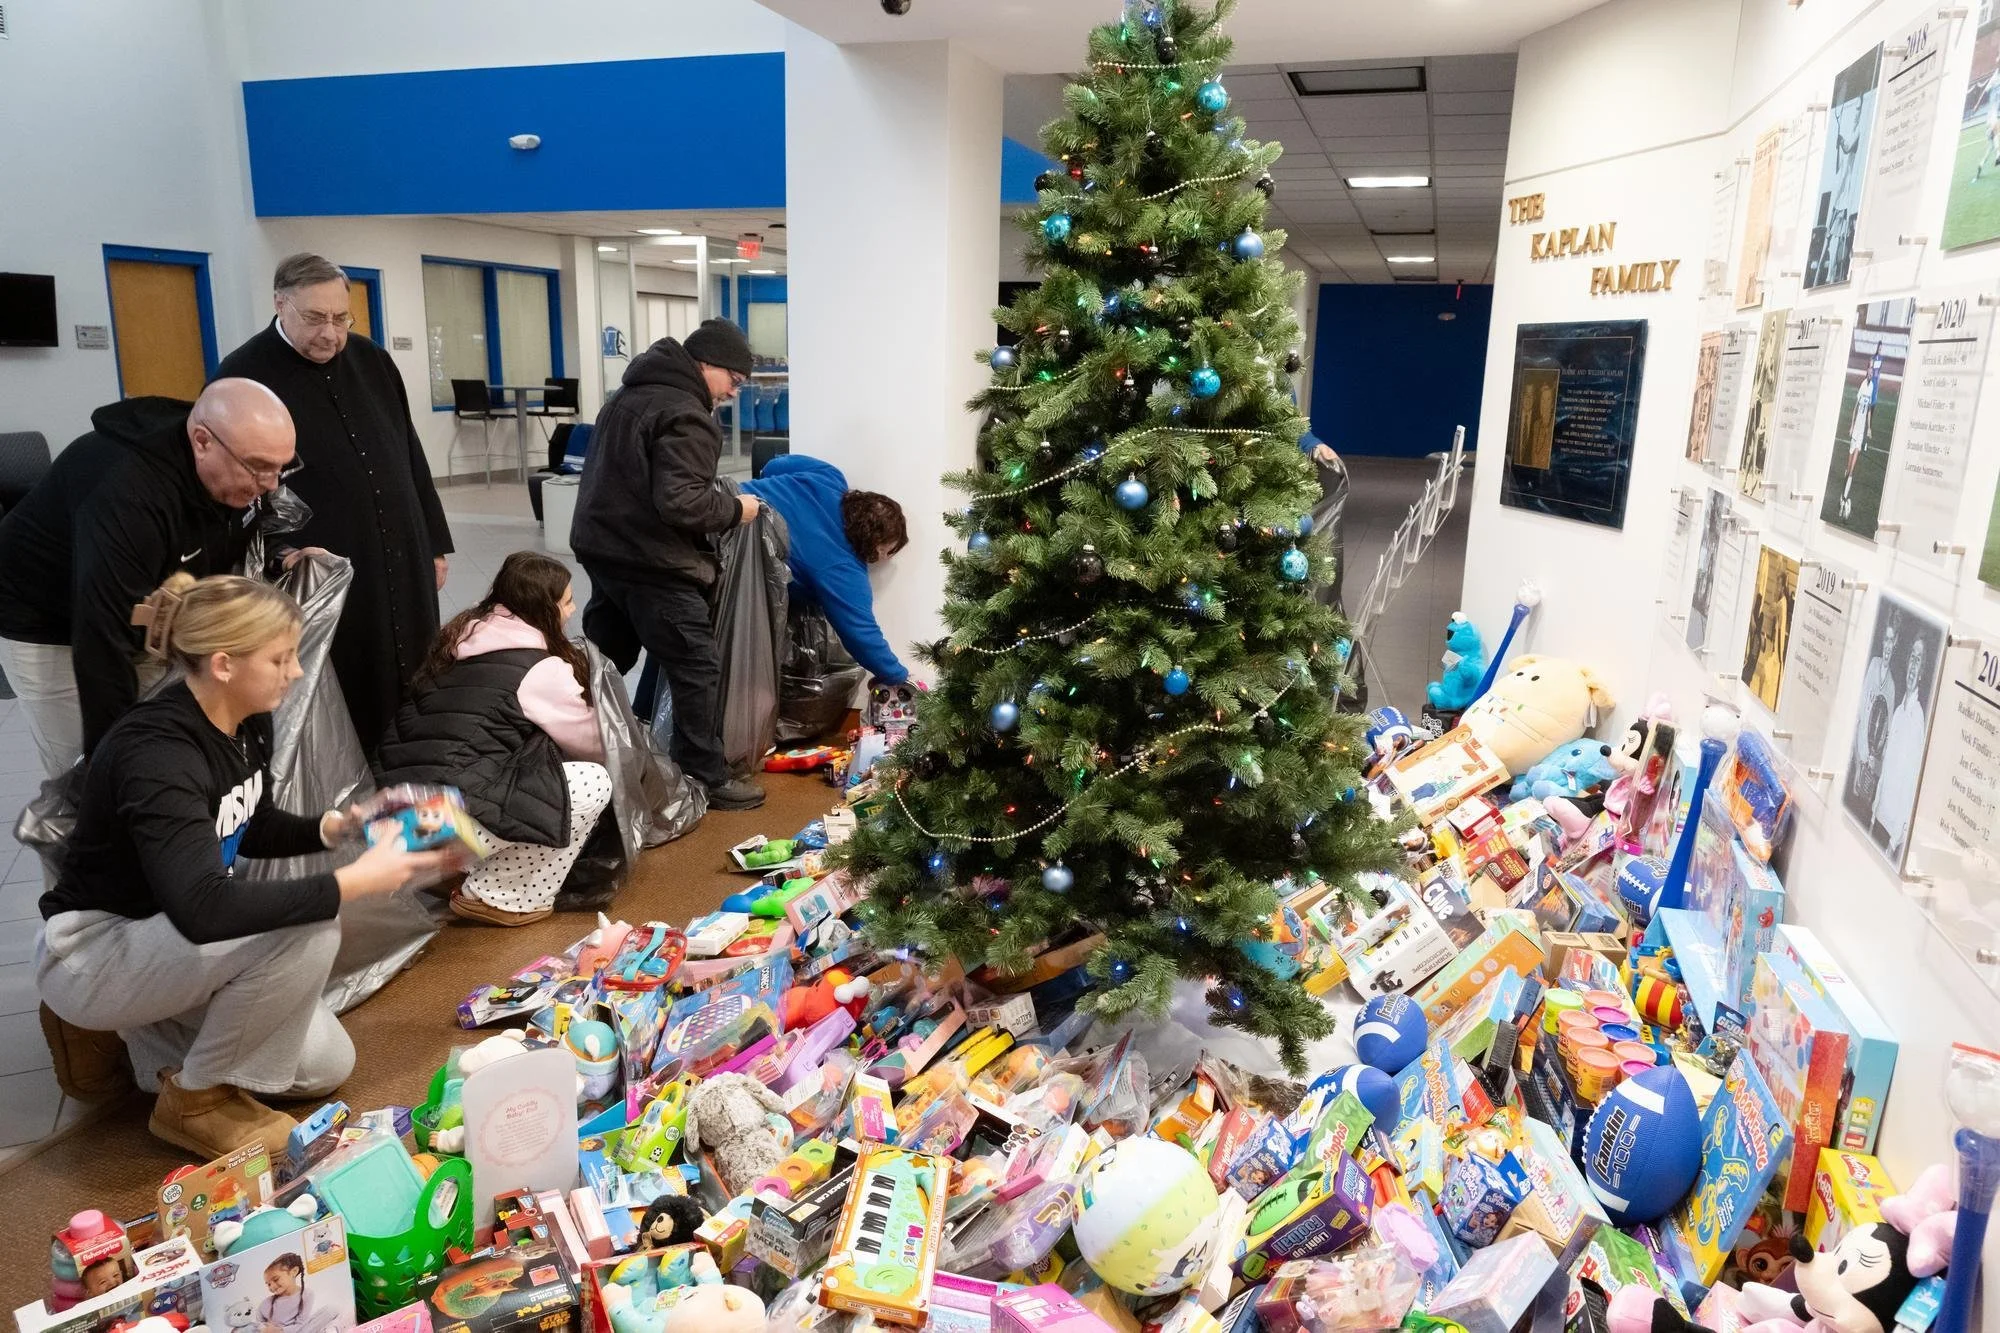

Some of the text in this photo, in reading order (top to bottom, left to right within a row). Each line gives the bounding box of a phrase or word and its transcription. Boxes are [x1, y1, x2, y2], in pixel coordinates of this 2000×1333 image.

[1904, 23, 1929, 61] 2018
[1508, 193, 1545, 223] THE
[1531, 222, 1617, 260] KAPLAN
[1591, 259, 1680, 295] FAMILY
[1937, 298, 1967, 329] 2020
[1816, 566, 1836, 595] 2019
[1978, 650, 2000, 692] 20
[1422, 883, 1454, 920] Clue
[1733, 1077, 1768, 1172] BOOMERANG
[1845, 1097, 1875, 1149] LIFE
[753, 1232, 790, 1258] RACE CAR
[1272, 1215, 1325, 1256] Football
[141, 1258, 191, 1283] MICKEY
[530, 1290, 551, 1303] CHILD
